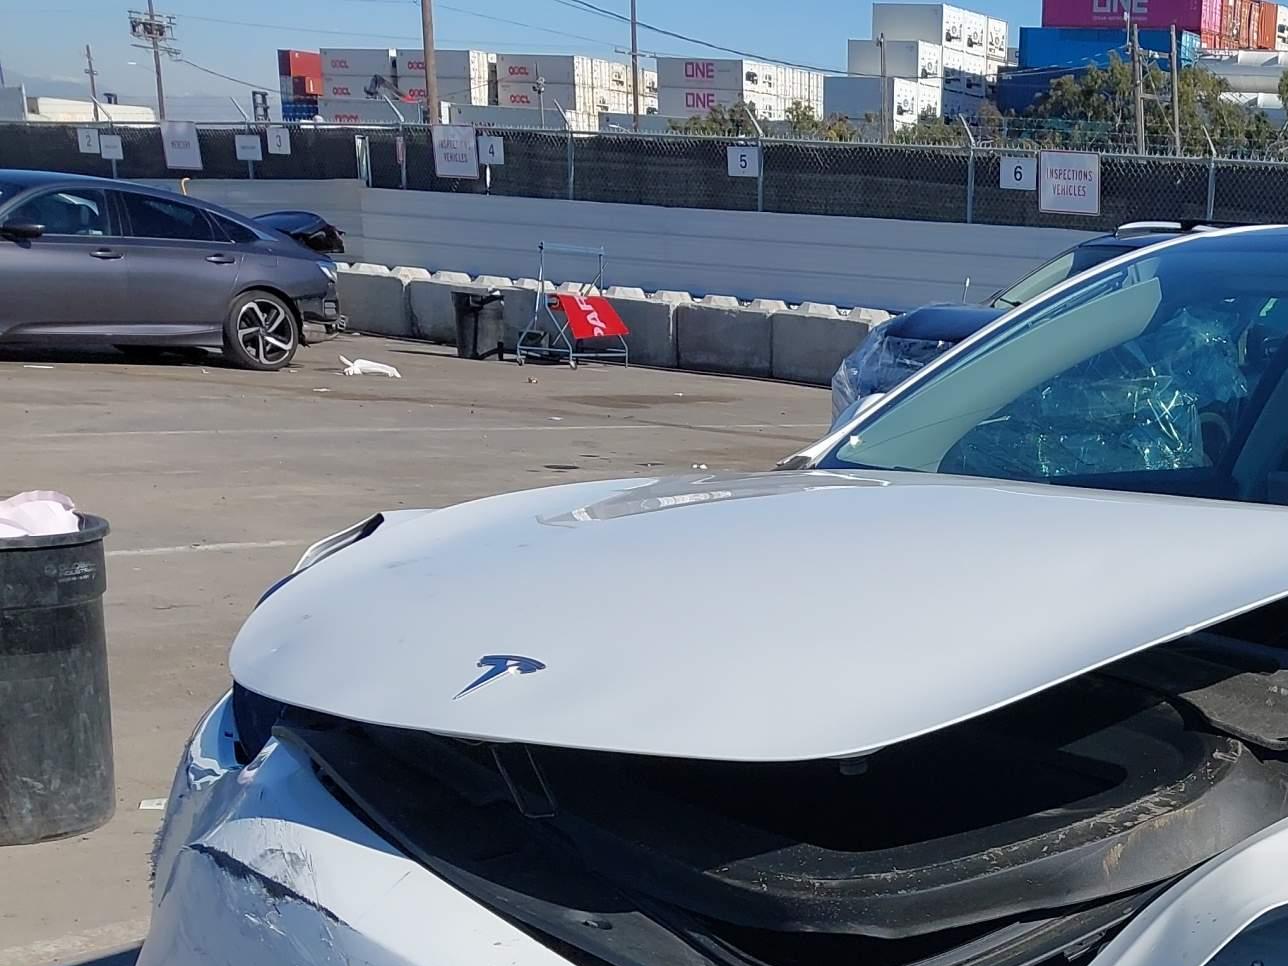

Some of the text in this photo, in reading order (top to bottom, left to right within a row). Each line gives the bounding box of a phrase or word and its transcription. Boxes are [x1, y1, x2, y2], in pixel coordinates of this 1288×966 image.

[685, 62, 715, 79] ONE
[686, 92, 716, 109] ONE
[85, 134, 92, 147] 2
[276, 134, 282, 148] 3
[488, 143, 495, 157] 4
[739, 154, 748, 169] 5
[1013, 165, 1023, 182] 6
[1046, 167, 1093, 182] INSPECTIONS
[1052, 183, 1087, 197] VEHICLES
